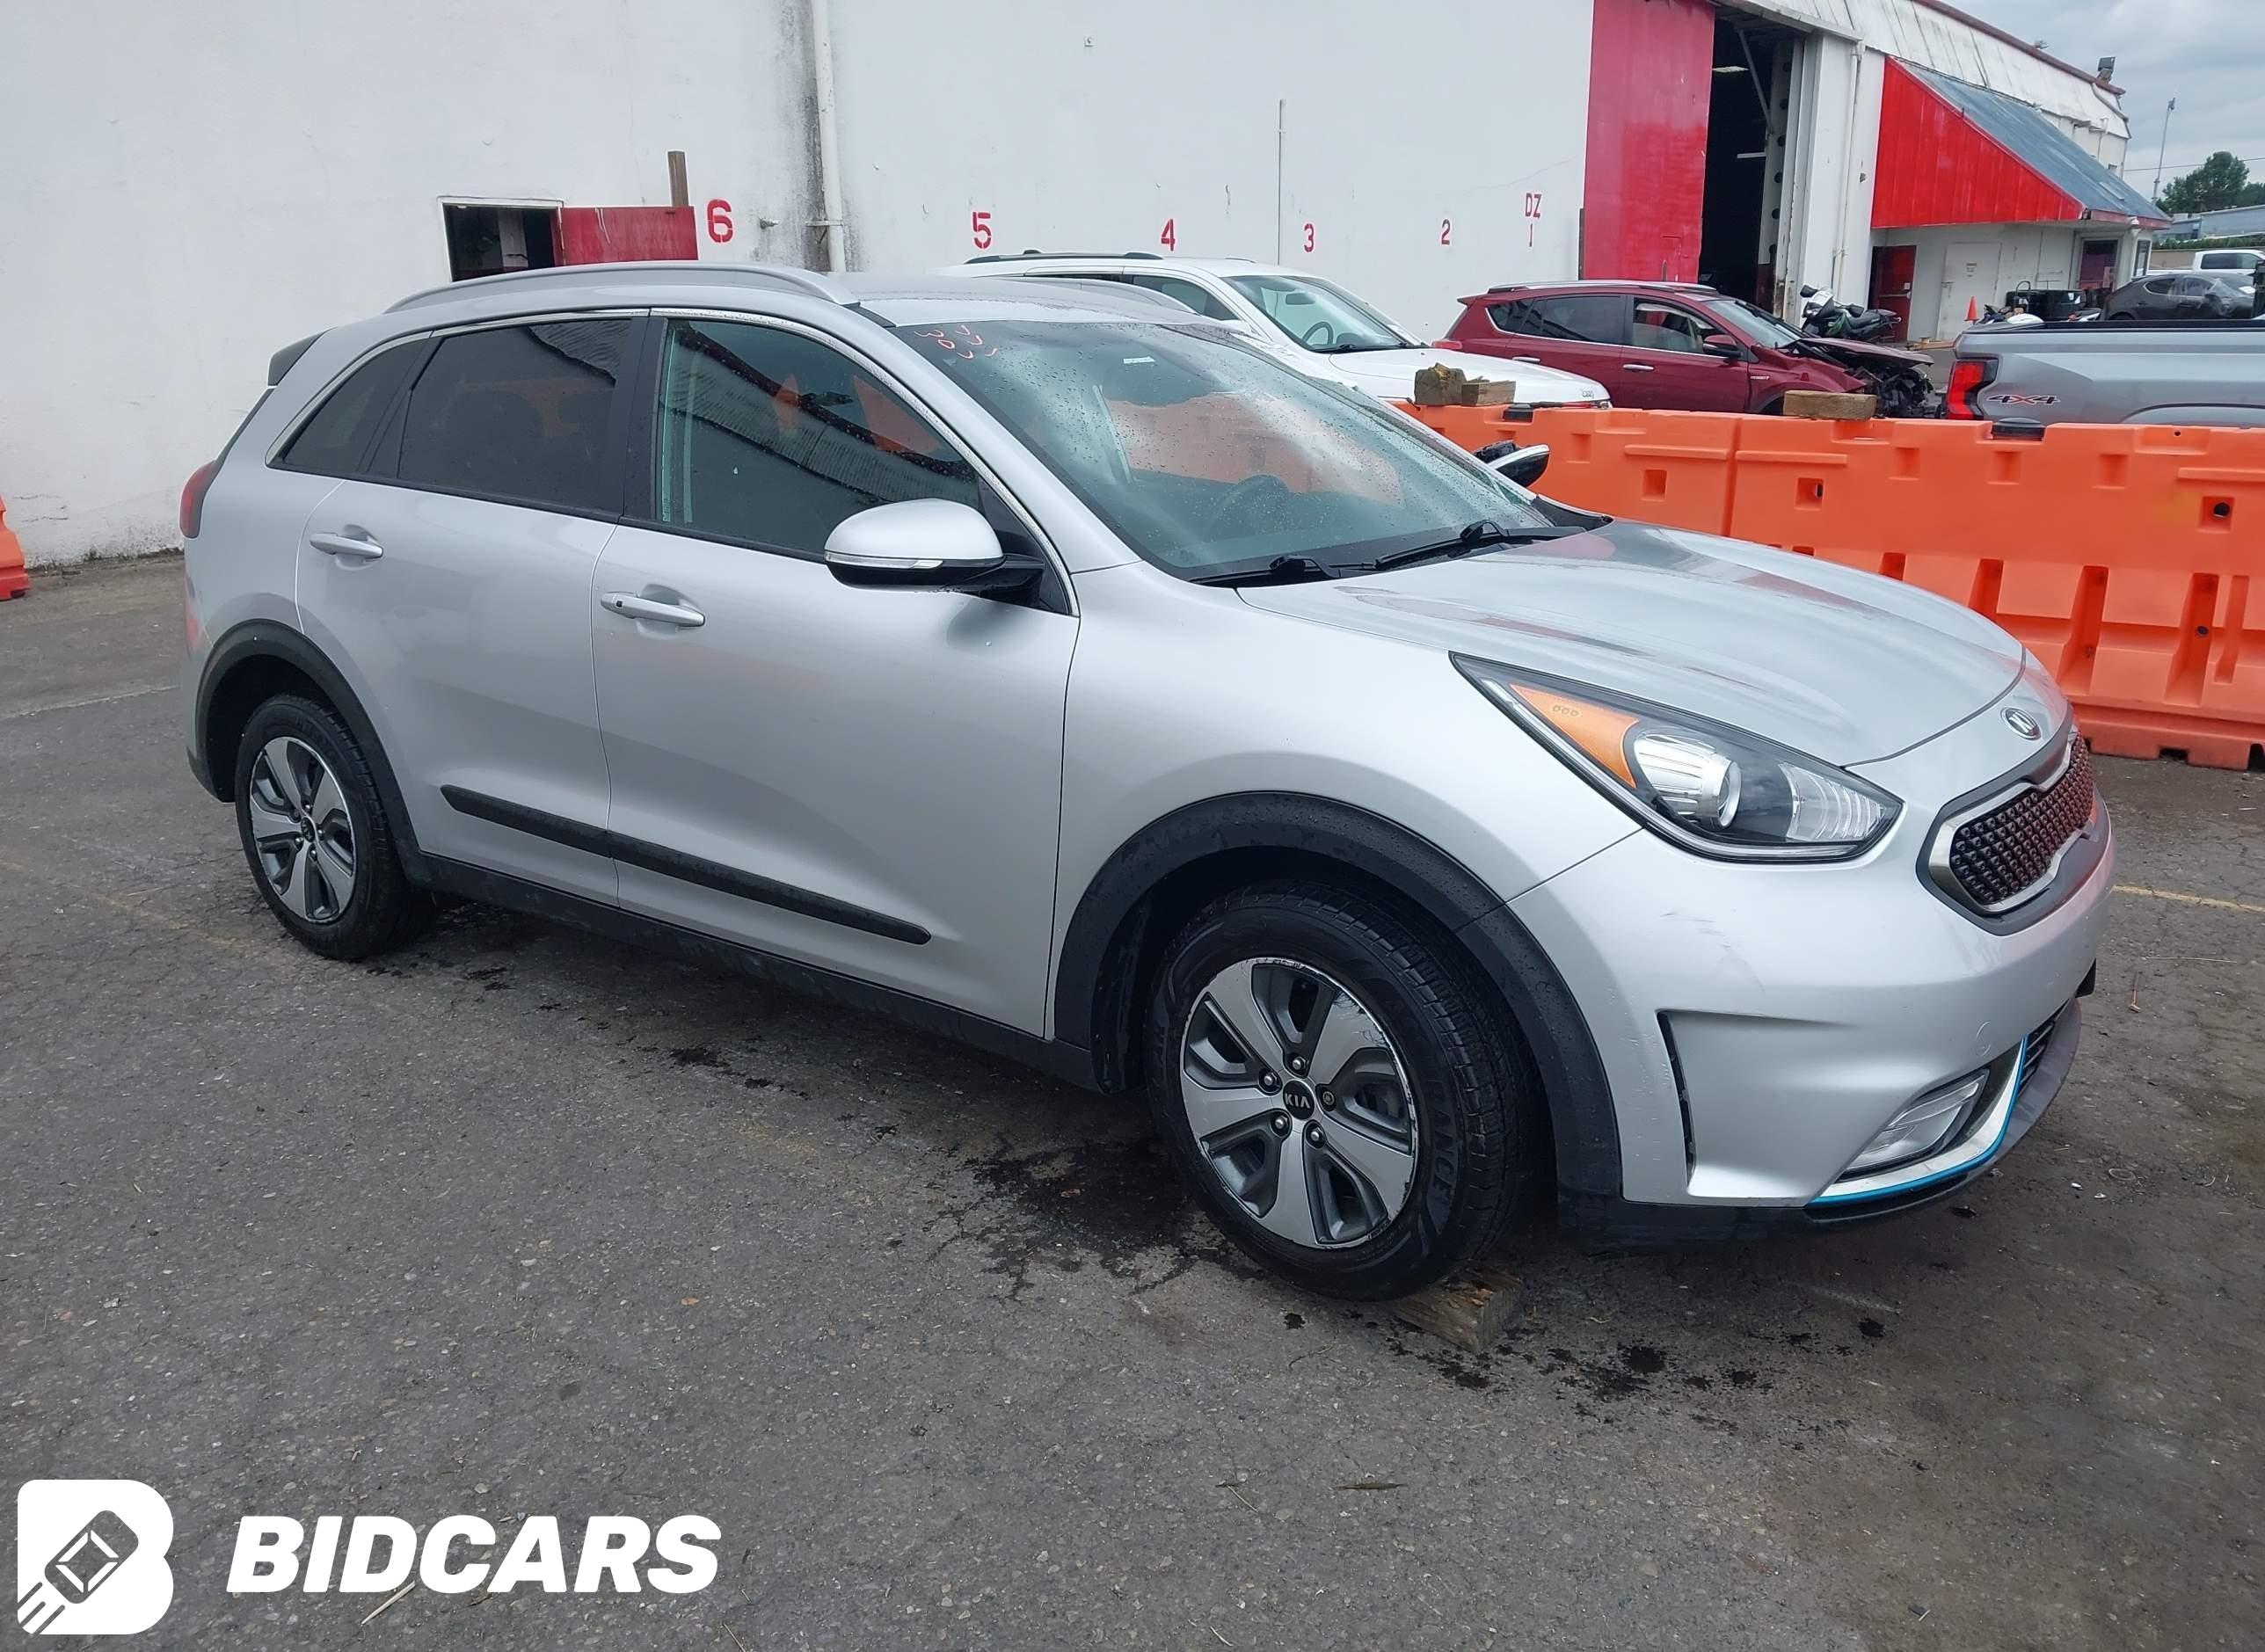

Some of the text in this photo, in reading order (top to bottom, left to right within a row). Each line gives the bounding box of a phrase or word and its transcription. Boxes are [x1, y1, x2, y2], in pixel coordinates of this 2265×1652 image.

[1525, 193, 1542, 218] DZ
[707, 199, 733, 244] 6
[972, 211, 992, 249] 5
[1161, 218, 1176, 251] 4
[1441, 218, 1451, 245] 2
[1304, 223, 1315, 252] 3
[1284, 1093, 1311, 1110] KIA
